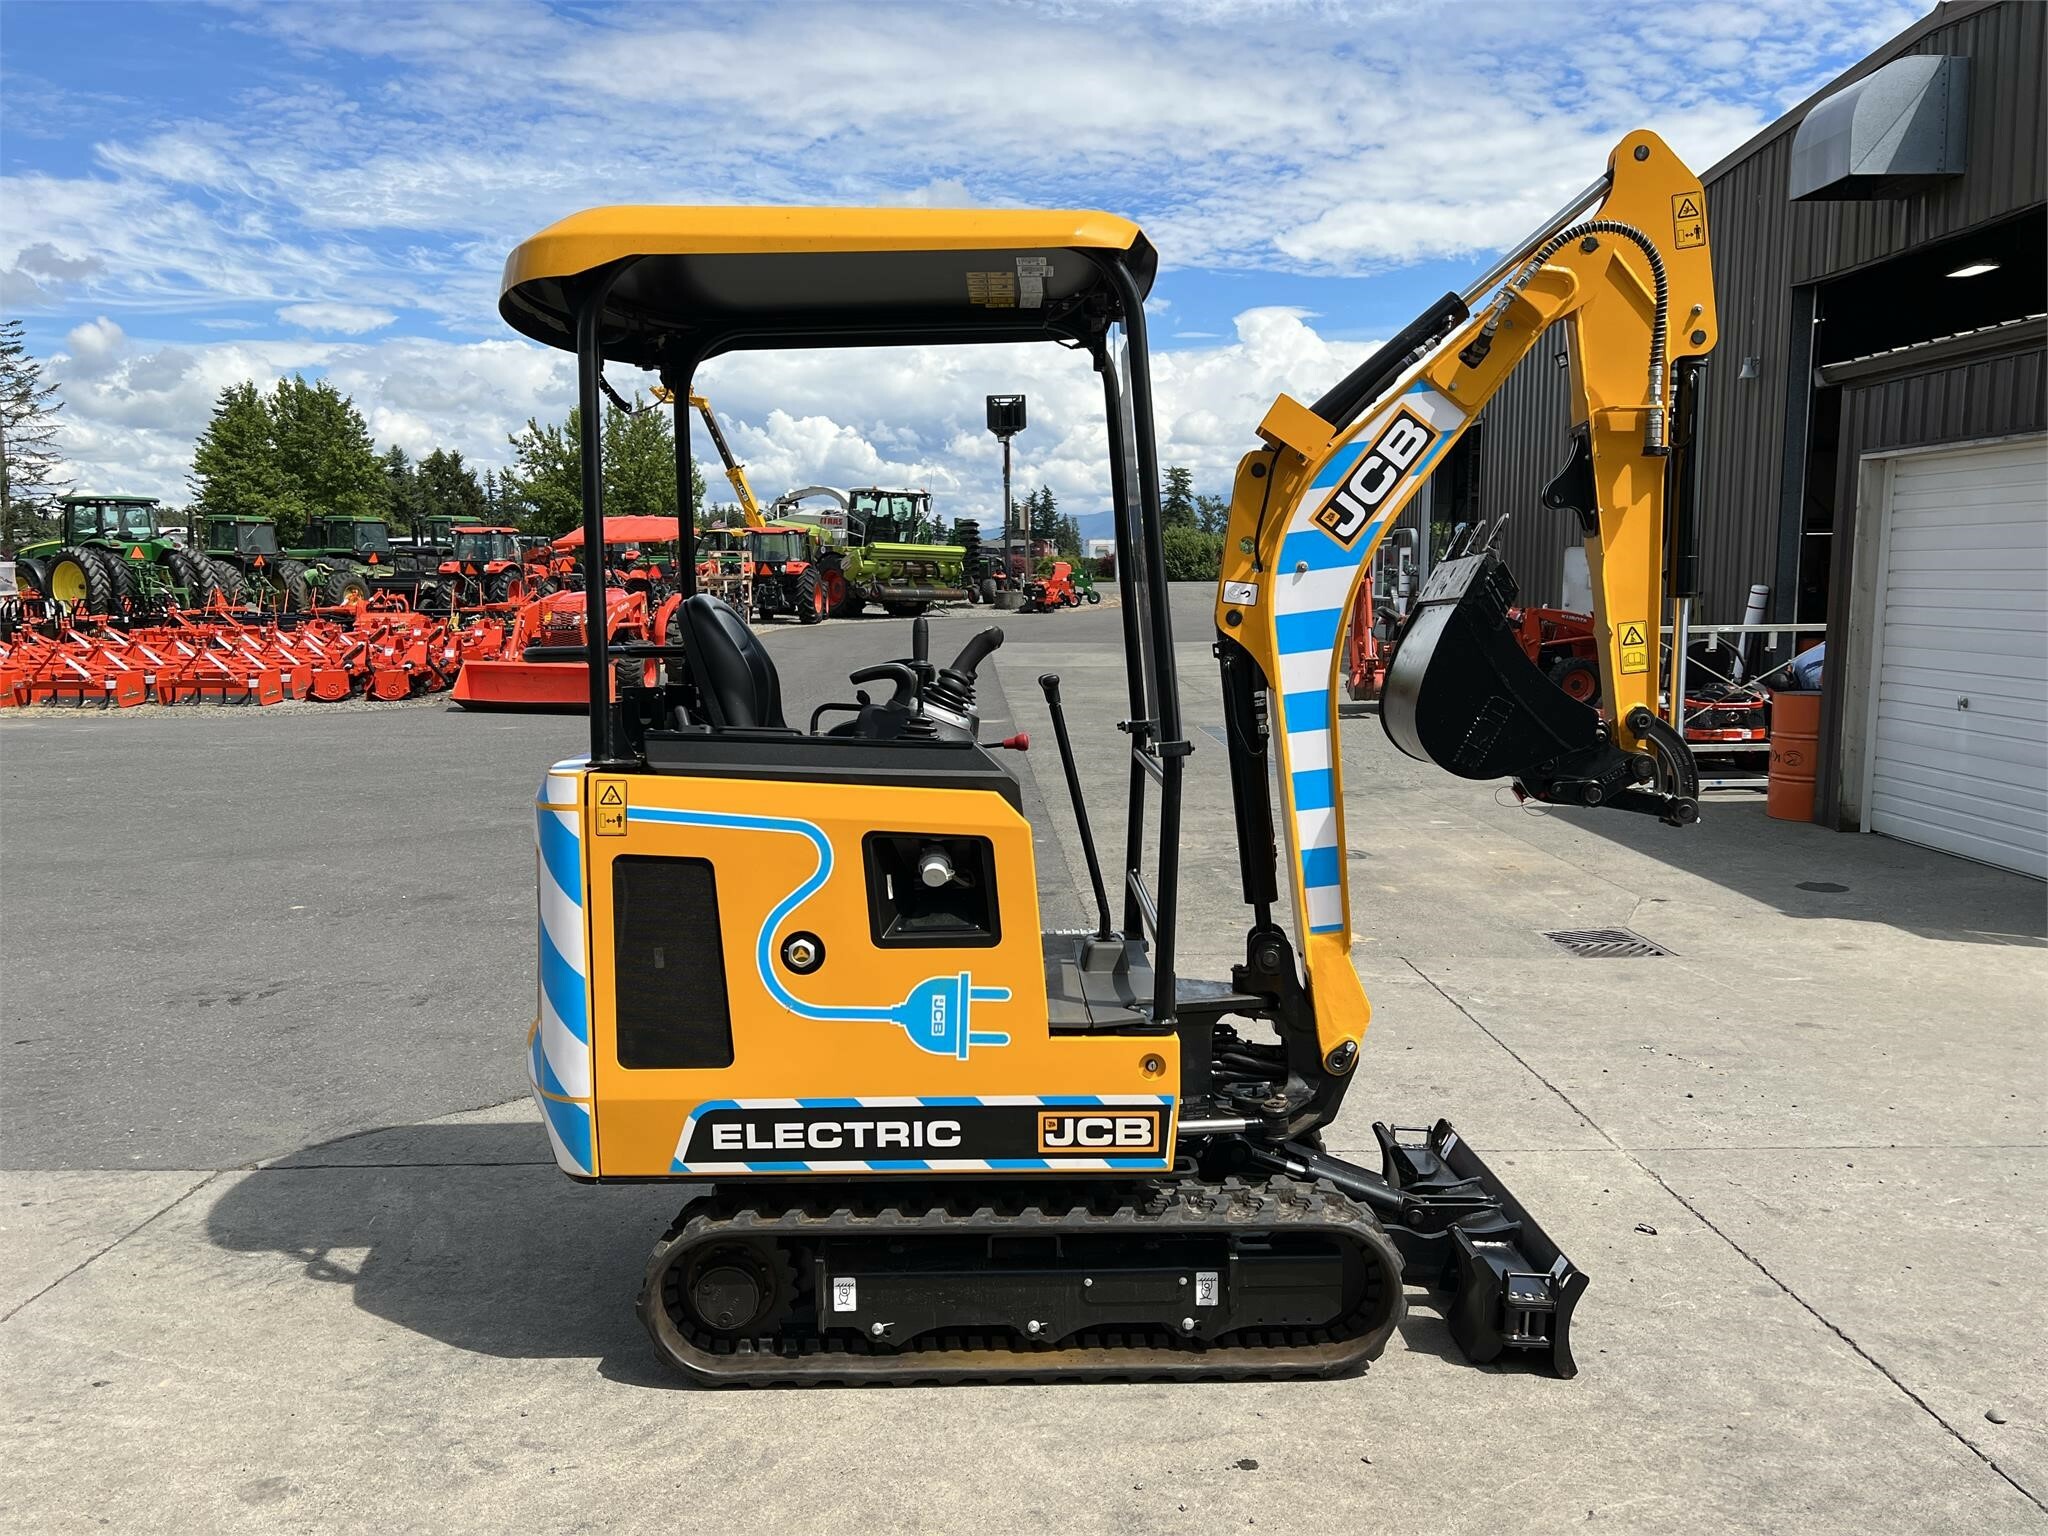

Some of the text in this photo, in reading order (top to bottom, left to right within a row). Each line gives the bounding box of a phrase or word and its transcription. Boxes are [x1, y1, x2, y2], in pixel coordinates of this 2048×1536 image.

[738, 482, 749, 501] JCB
[1335, 418, 1428, 537] JCB
[933, 998, 944, 1034] JCB
[712, 1120, 961, 1150] ELECTRIC
[1045, 1117, 1152, 1147] JCB
